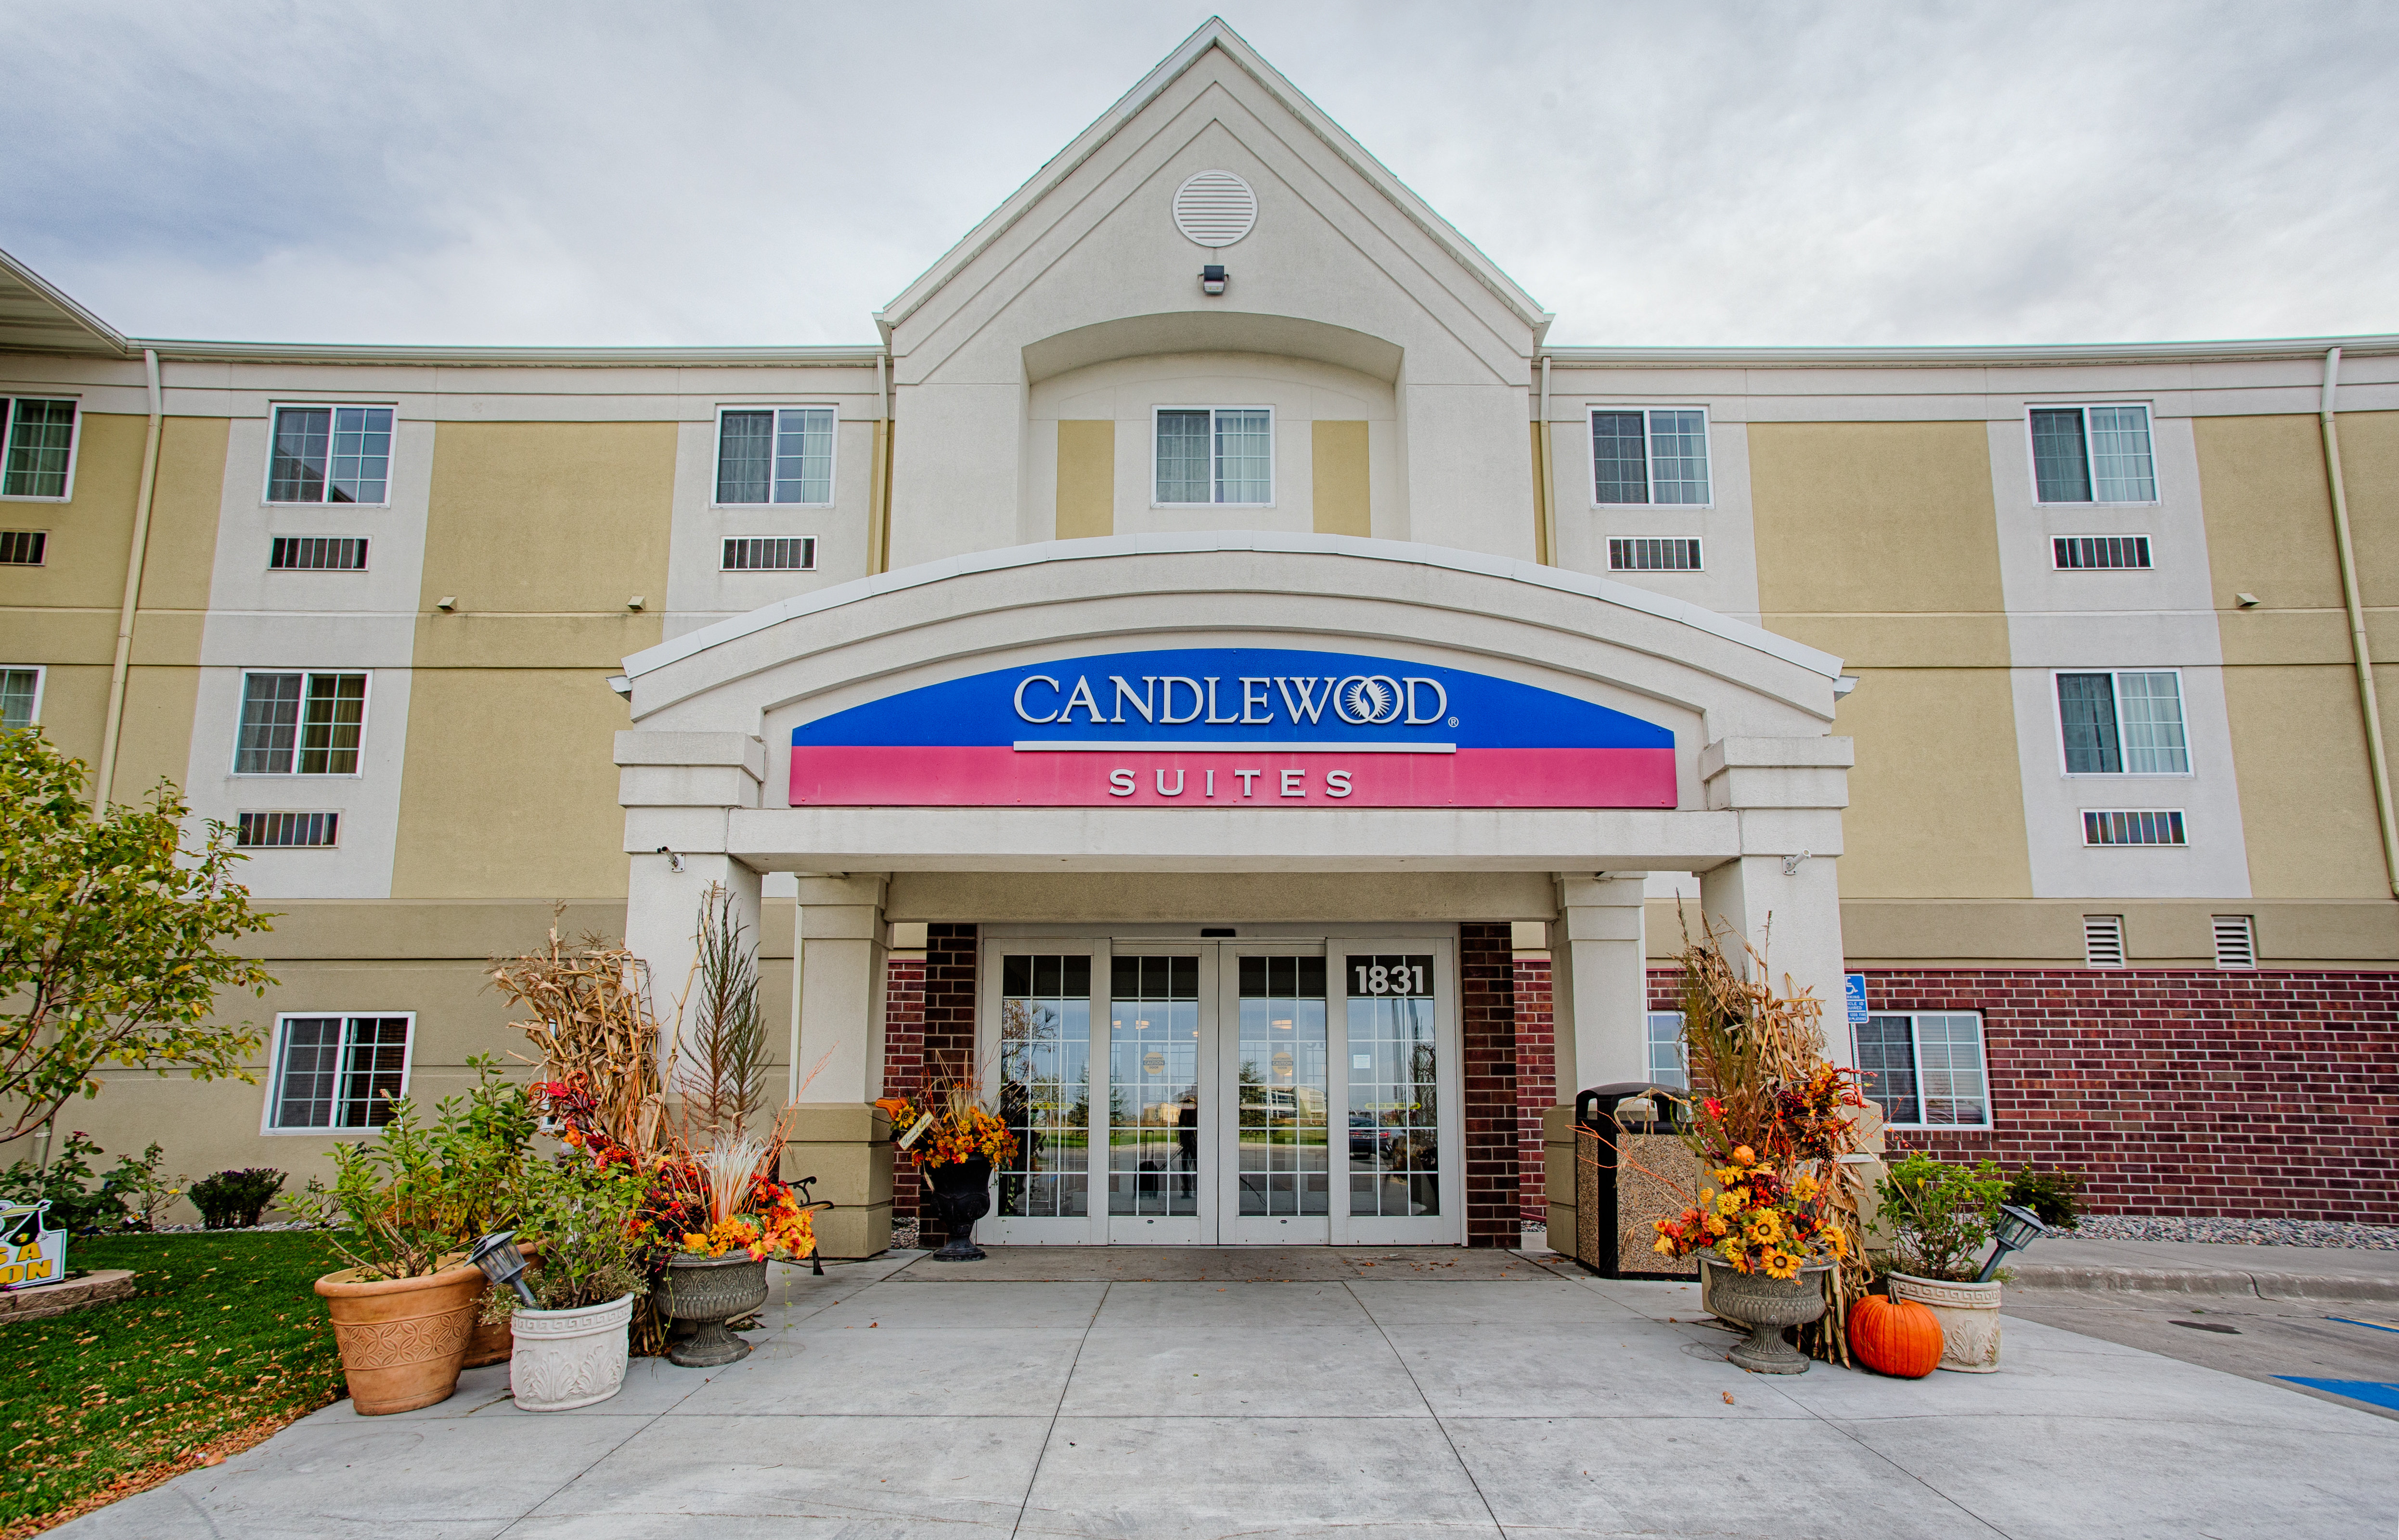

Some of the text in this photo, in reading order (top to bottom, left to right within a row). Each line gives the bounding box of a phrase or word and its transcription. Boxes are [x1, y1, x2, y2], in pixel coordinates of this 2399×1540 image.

[1014, 675, 1447, 724] CANDLEWOOD
[1109, 769, 1353, 797] SUITES
[1355, 965, 1423, 994] 1831
[902, 1127, 919, 1147] Harvest
[15, 1242, 43, 1262] A
